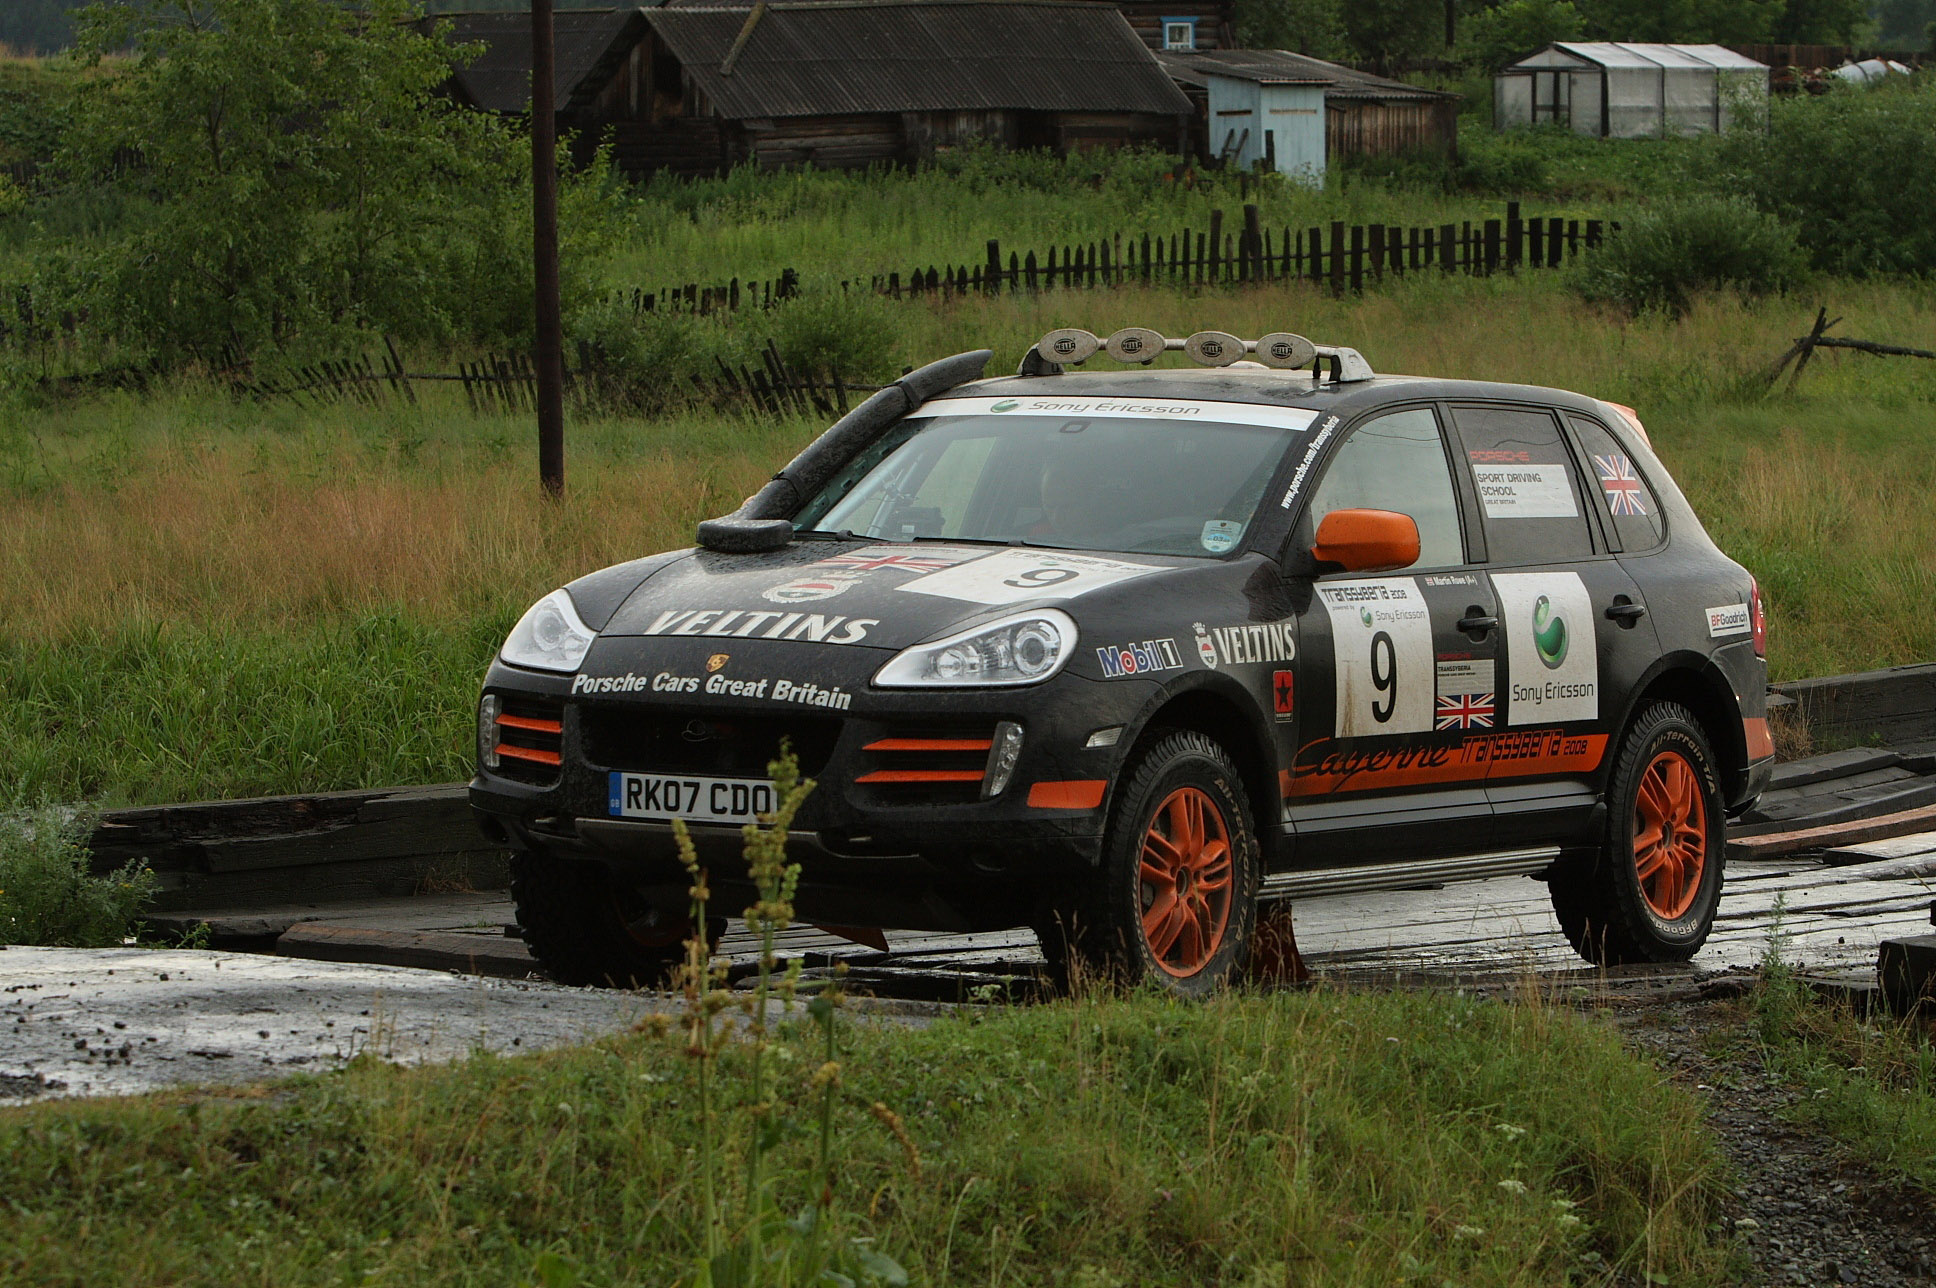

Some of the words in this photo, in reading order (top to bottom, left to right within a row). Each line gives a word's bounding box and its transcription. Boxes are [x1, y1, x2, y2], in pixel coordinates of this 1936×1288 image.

[1028, 401, 1090, 412] Sony
[1094, 402, 1201, 415] Ericsson
[1281, 416, 1340, 509] www.porsche.com/transsyberia
[1469, 451, 1531, 462] PORSCHE
[1477, 473, 1505, 483] SPORT
[1506, 473, 1543, 483] DRIVING
[1481, 487, 1517, 496] SCHOOL
[1003, 568, 1080, 588] 9
[1390, 590, 1408, 600] 2008
[1349, 604, 1355, 612] by
[1375, 610, 1395, 622] Sony
[1395, 609, 1426, 621] Ericsson
[644, 610, 880, 644] VELTINS
[1711, 611, 1748, 627] BFGoodrich
[1213, 624, 1296, 664] VELTINS
[1096, 640, 1162, 678] Mobil
[1370, 631, 1397, 723] 9
[571, 672, 647, 694] Porsche
[652, 672, 700, 694] Cars
[705, 674, 767, 698] Great
[772, 679, 852, 710] Britain
[1512, 683, 1542, 705] Sony
[1545, 682, 1594, 700] Ericsson
[1563, 740, 1588, 756] 2008
[1288, 736, 1451, 794] Cayenne
[626, 778, 700, 813] RK07
